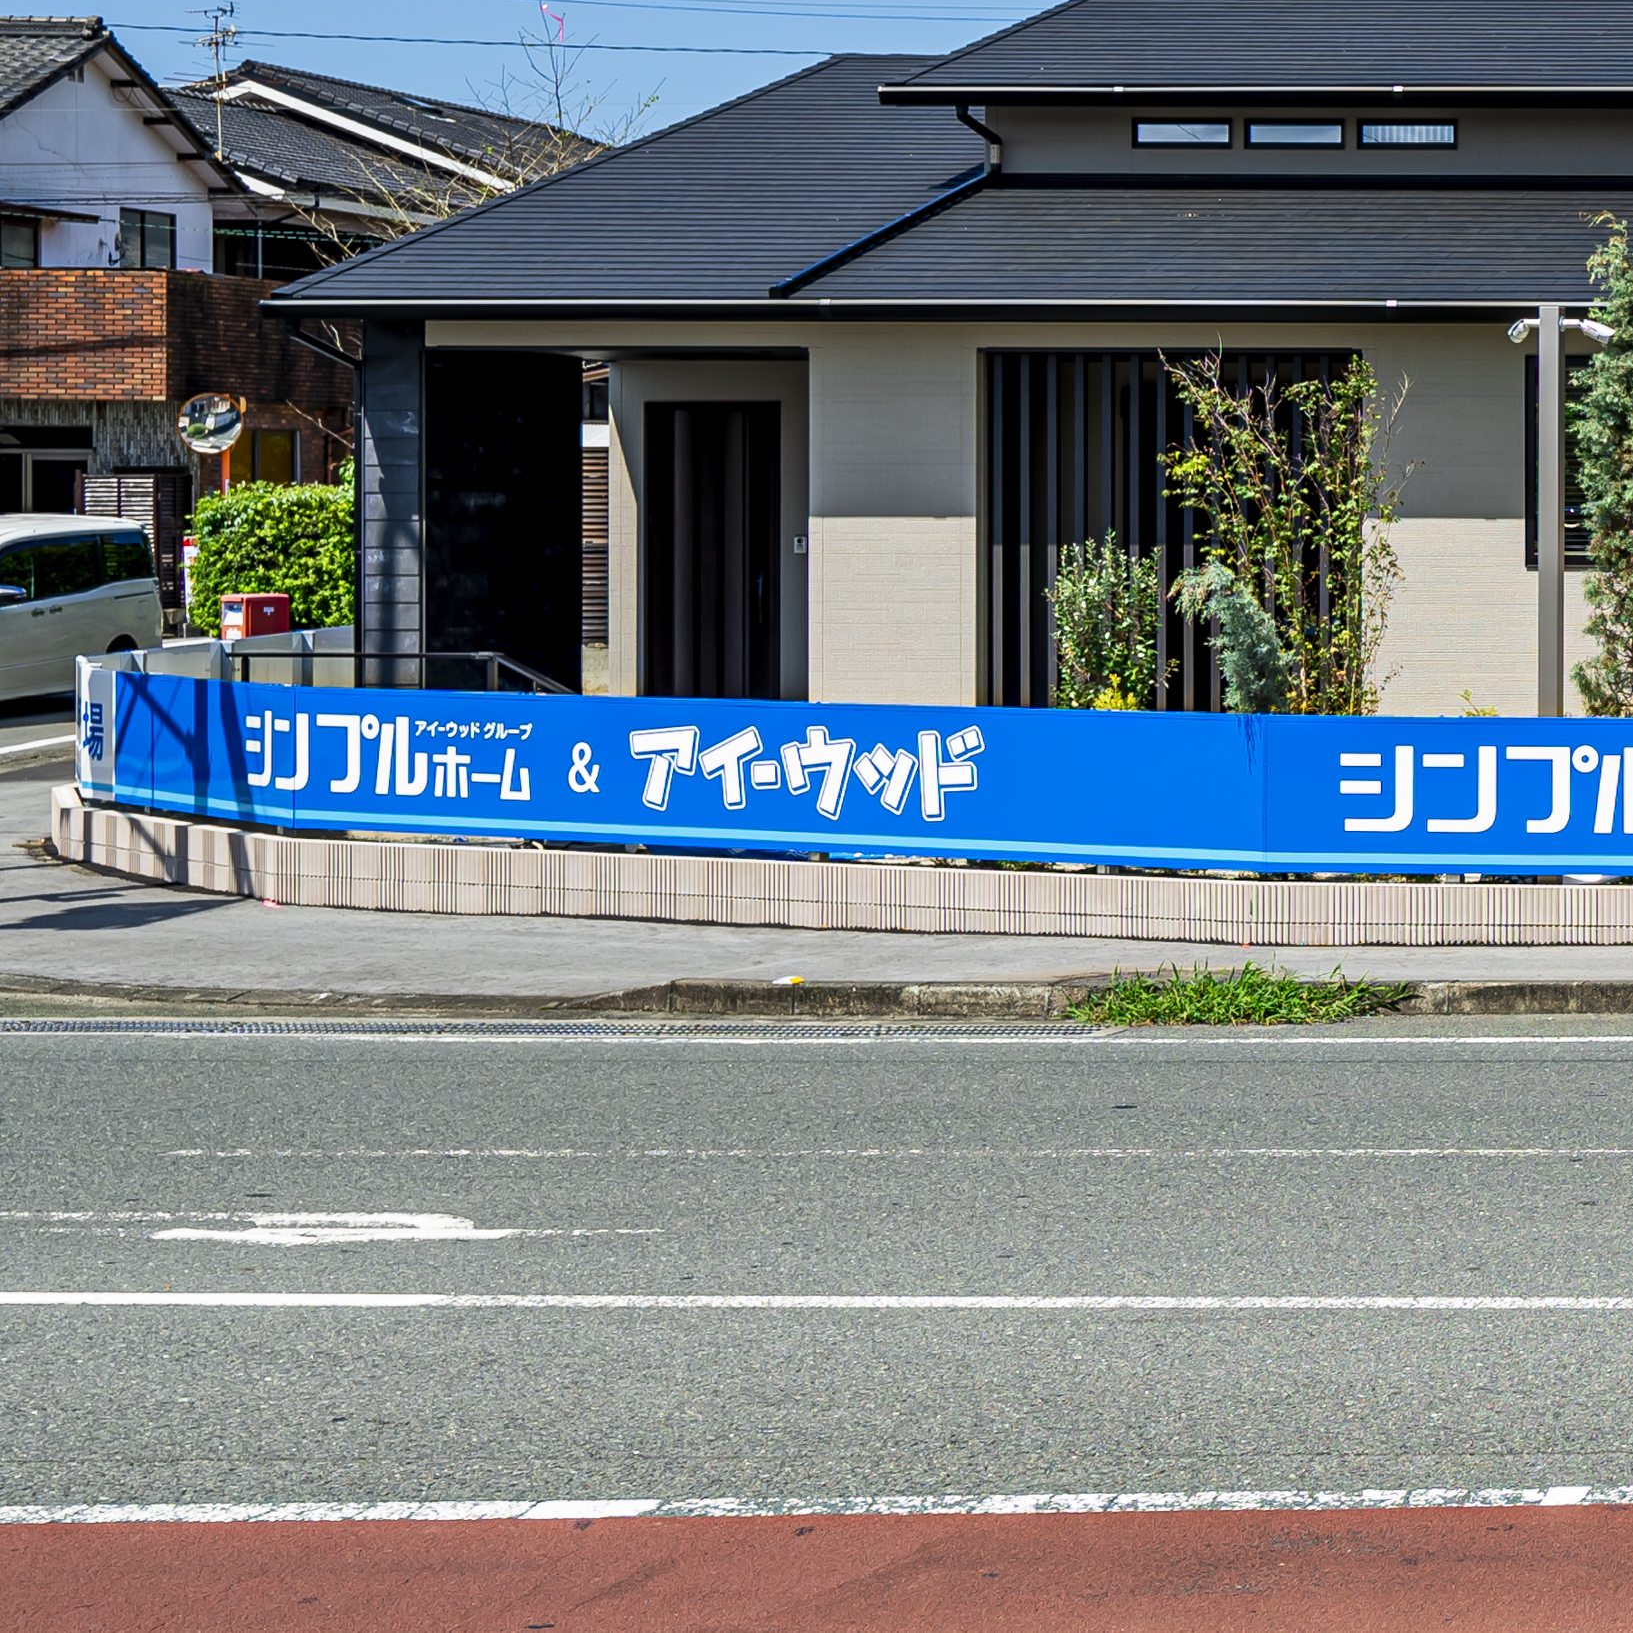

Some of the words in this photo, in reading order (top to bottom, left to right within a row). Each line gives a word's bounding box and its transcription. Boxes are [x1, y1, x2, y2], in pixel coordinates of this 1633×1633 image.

[483, 722, 532, 740] グループ
[568, 742, 600, 793] &
